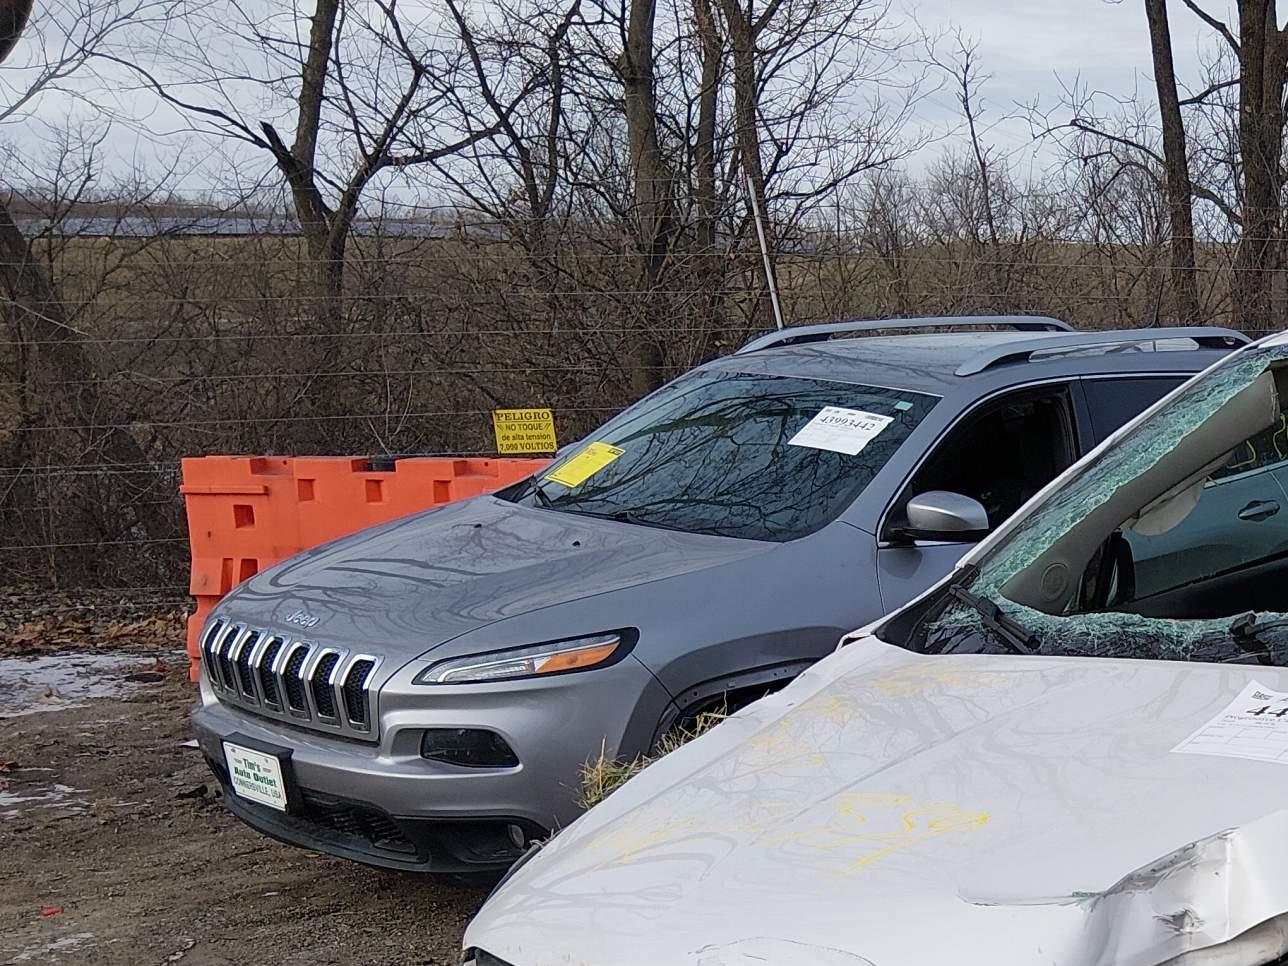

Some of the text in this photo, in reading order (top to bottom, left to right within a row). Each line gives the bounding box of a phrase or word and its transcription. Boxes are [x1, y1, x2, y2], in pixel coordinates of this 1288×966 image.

[495, 411, 550, 421] PELIGRO
[820, 415, 876, 431] 43993442
[518, 423, 543, 431] TOQUE
[520, 442, 554, 450] VOLTIOS
[285, 610, 320, 629] Jeep
[243, 758, 261, 773] Tim's
[233, 766, 278, 788] Auto Outlet
